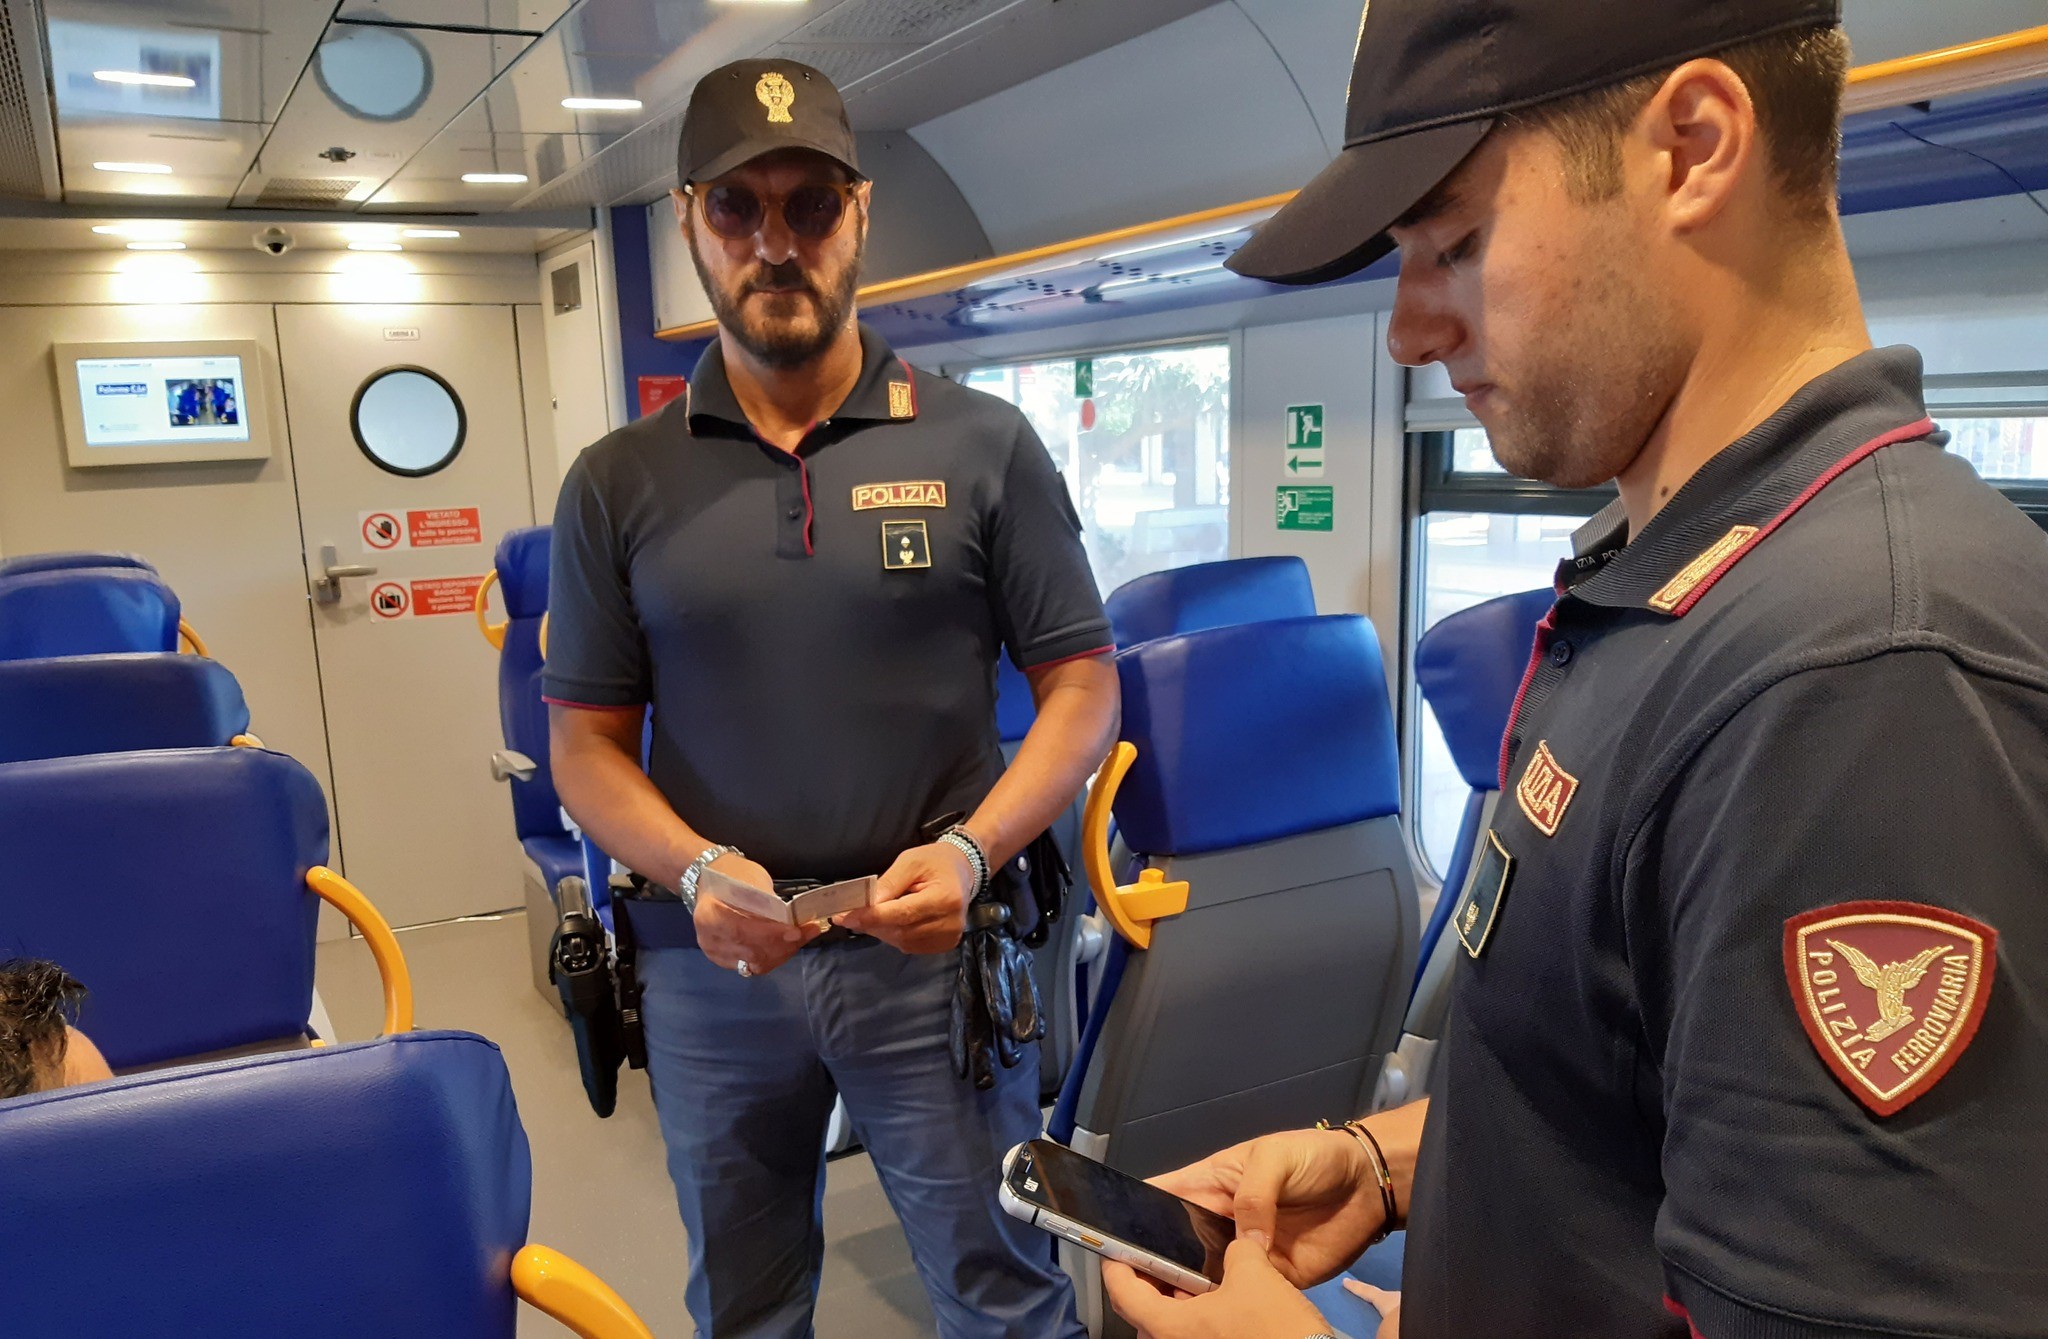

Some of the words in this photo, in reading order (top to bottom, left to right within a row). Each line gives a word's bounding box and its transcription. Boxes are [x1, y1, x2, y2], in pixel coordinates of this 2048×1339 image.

[426, 510, 460, 520] VIETATO
[857, 485, 942, 507] POLIZIA
[1809, 951, 1877, 1070] POLIZIA
[1889, 954, 1970, 1075] FERROVIARIA
